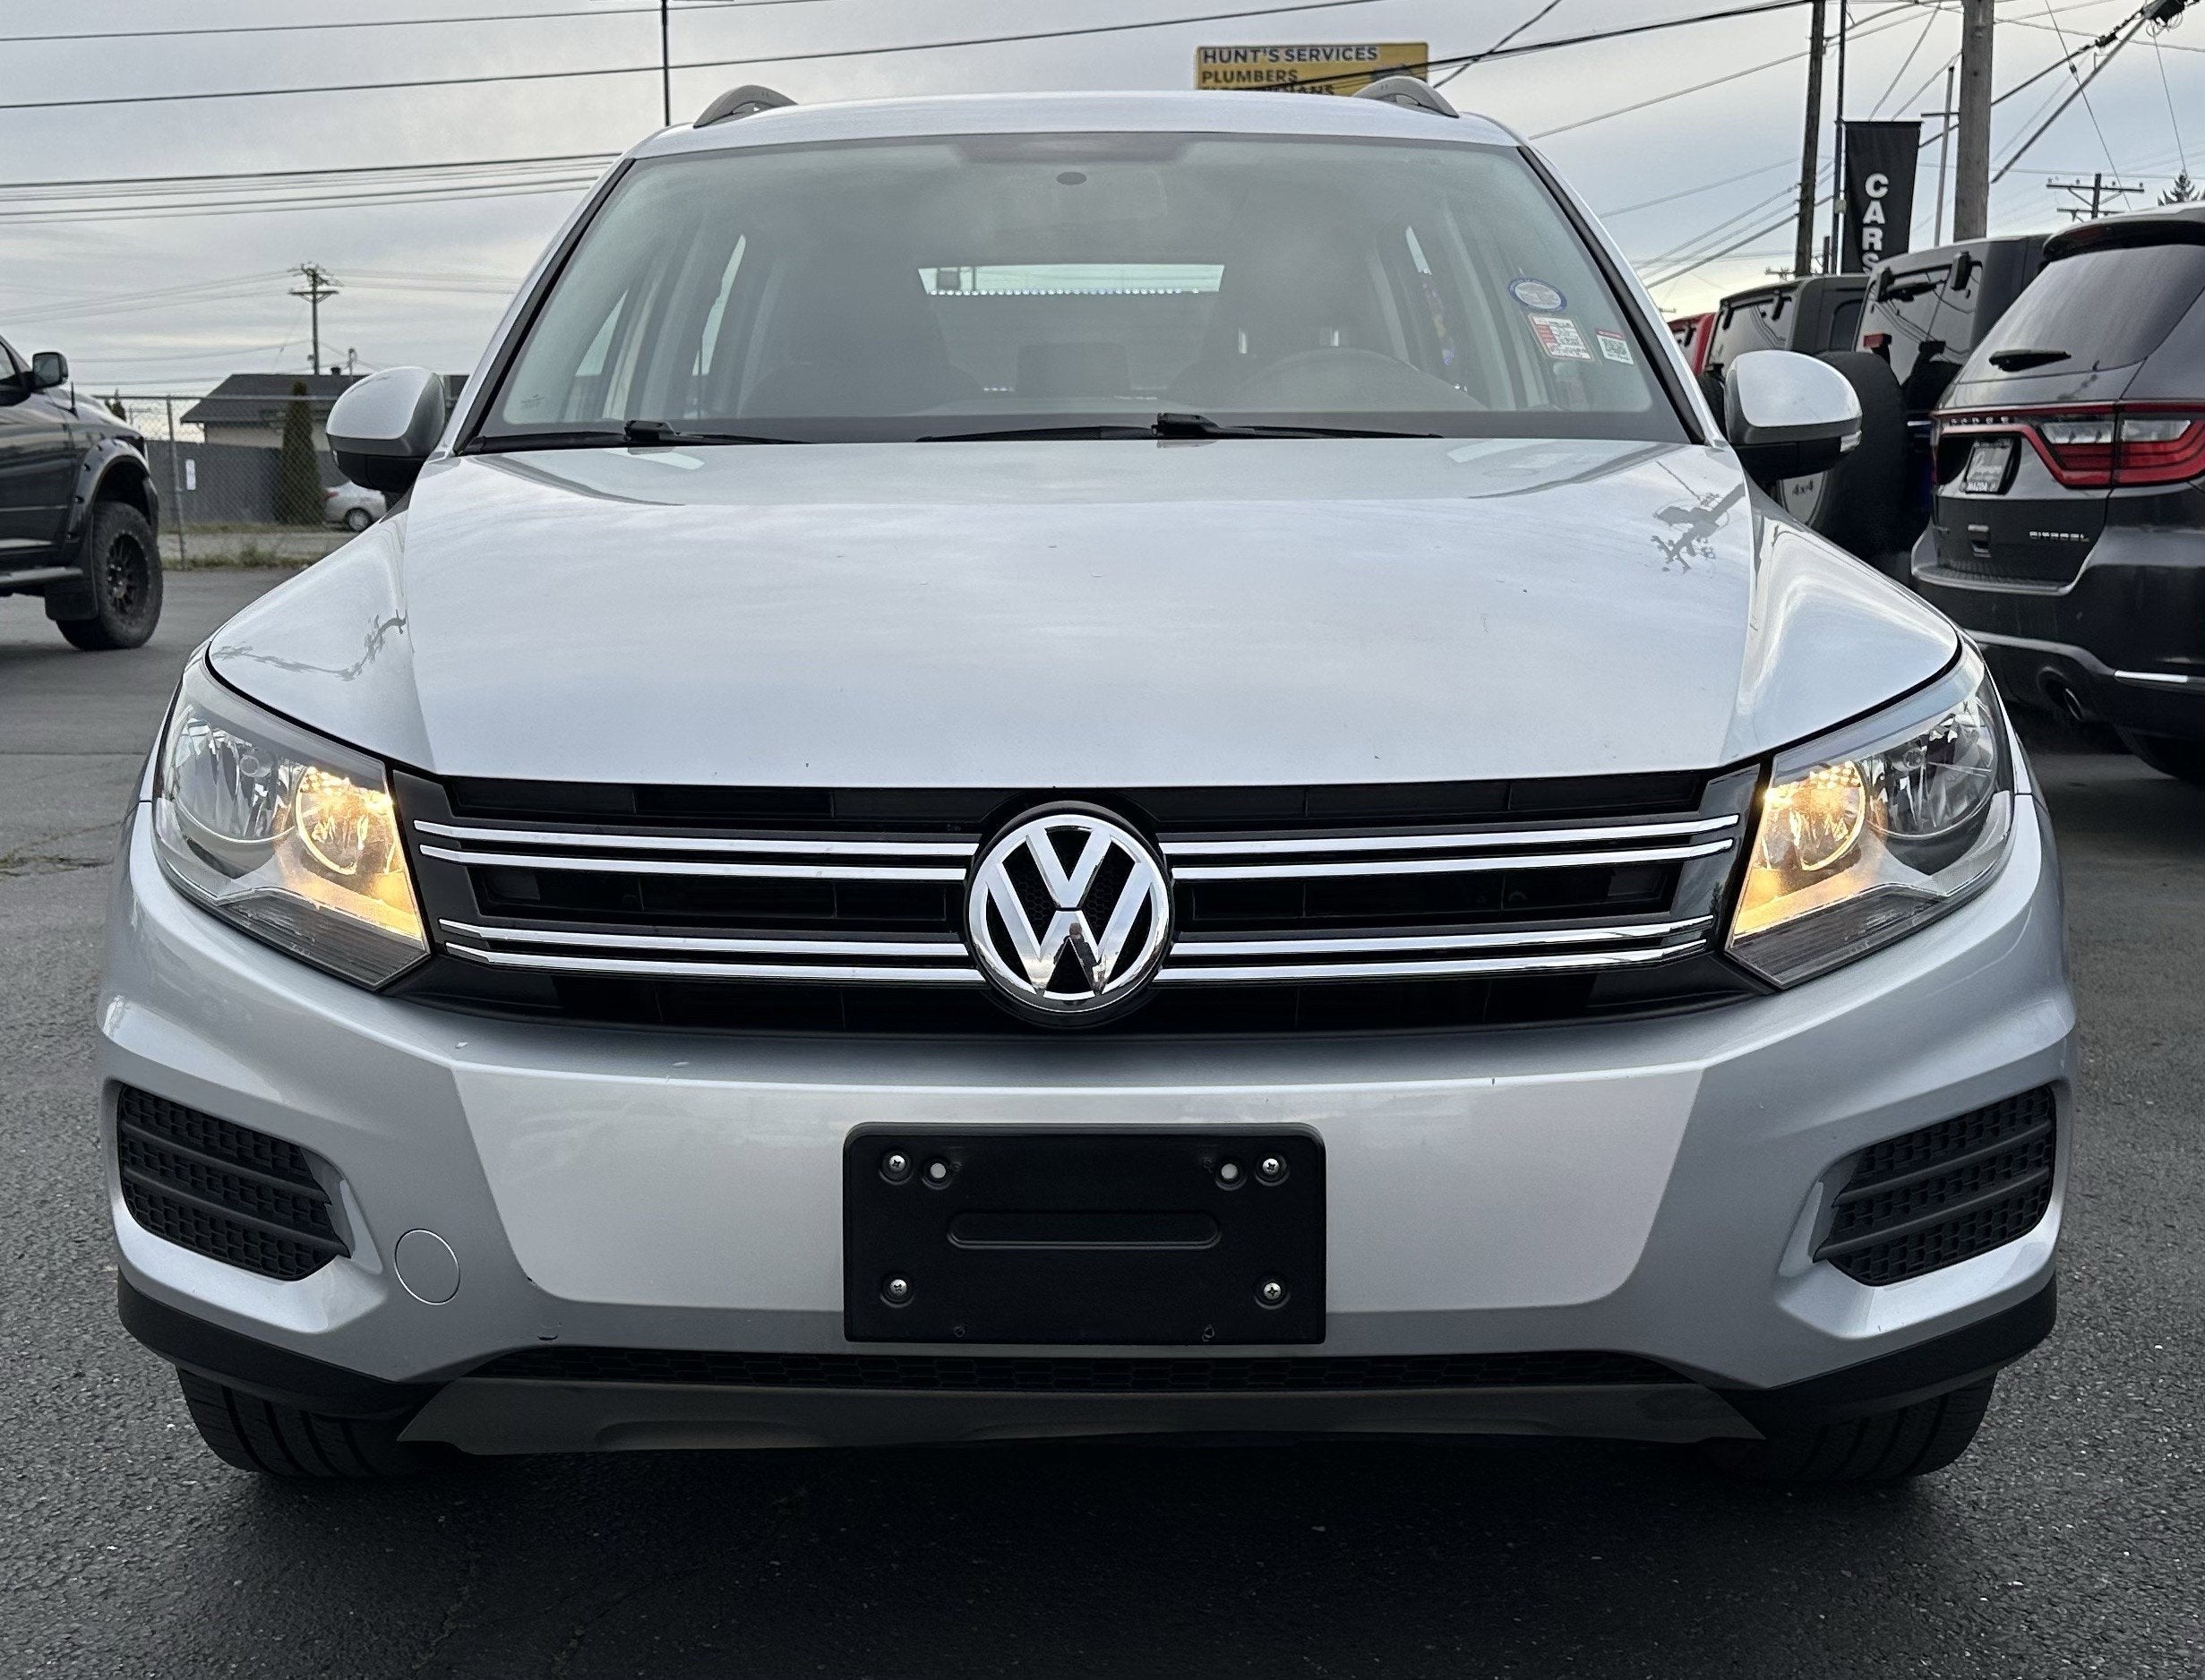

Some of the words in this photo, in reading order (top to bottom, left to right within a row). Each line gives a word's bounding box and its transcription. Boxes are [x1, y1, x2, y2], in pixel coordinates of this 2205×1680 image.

[1204, 48, 1280, 63] HUNT'S
[1284, 47, 1378, 62] SERVICES
[1202, 70, 1299, 83] PLUMBERS
[983, 819, 1158, 997] VW
